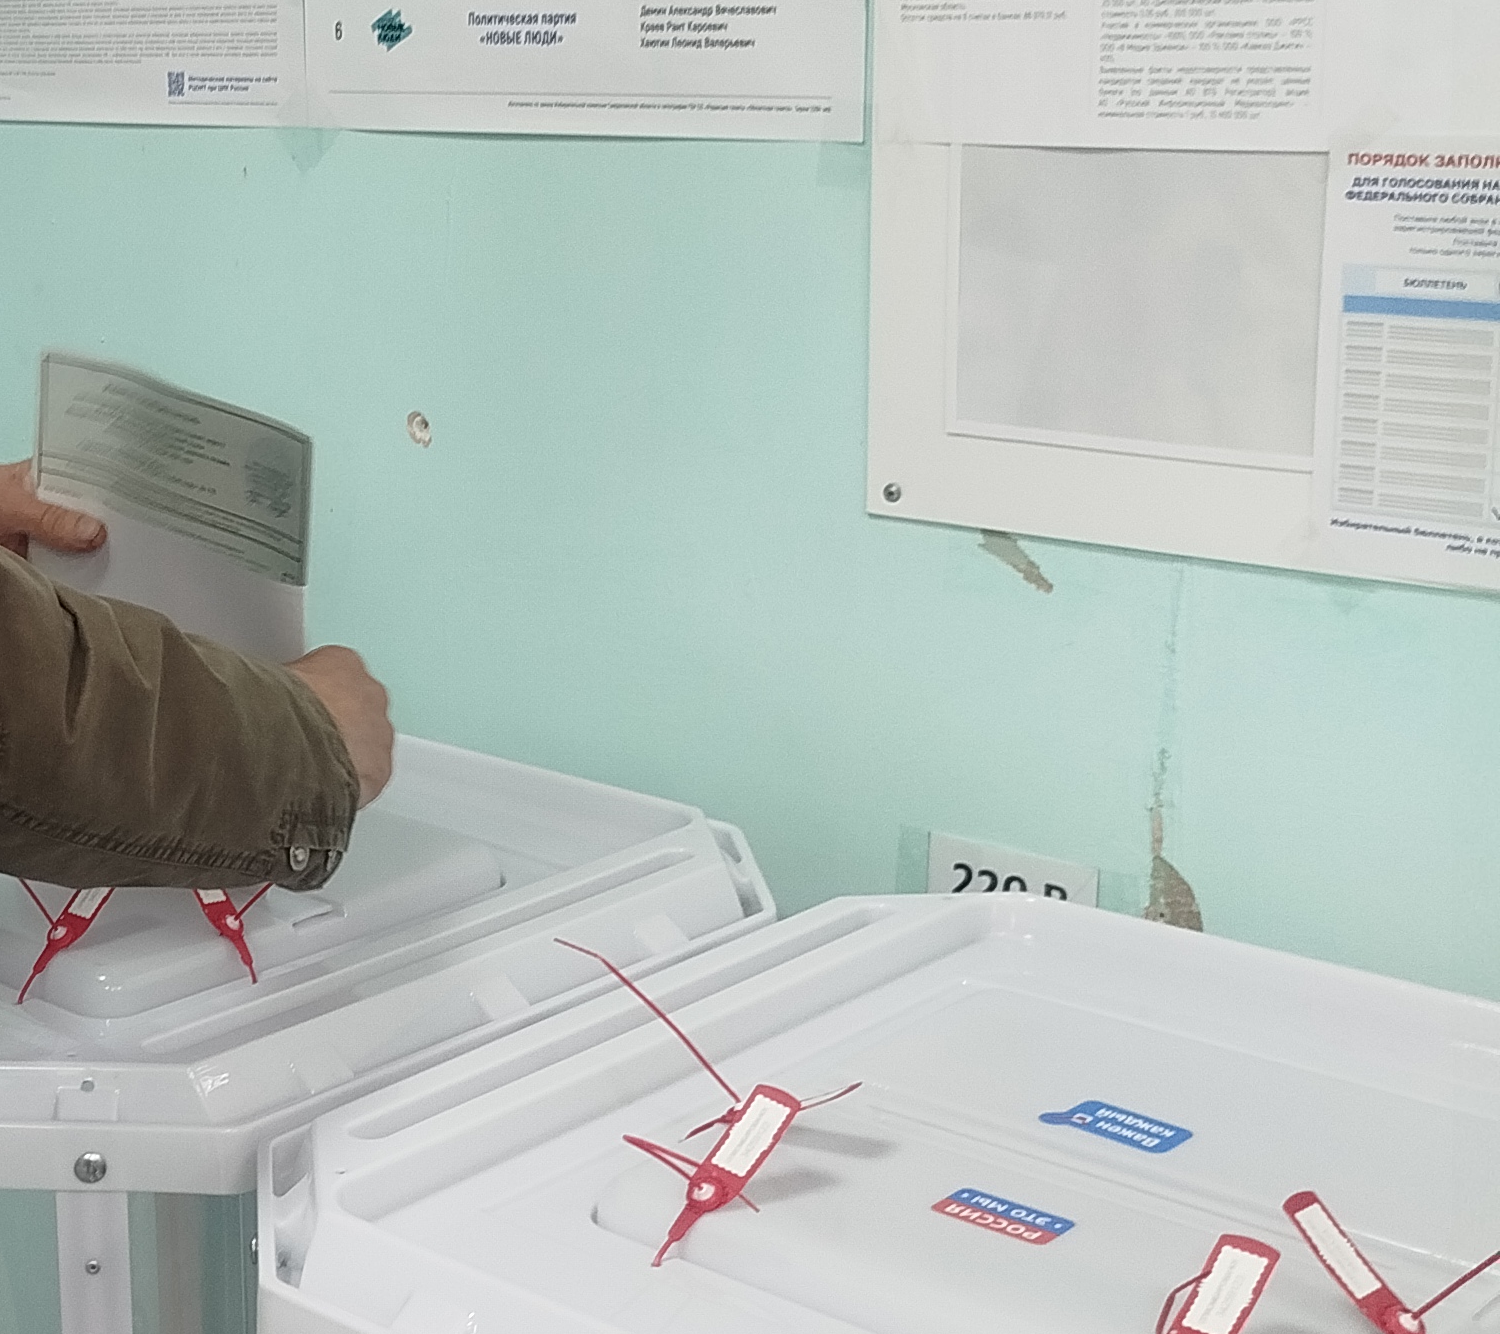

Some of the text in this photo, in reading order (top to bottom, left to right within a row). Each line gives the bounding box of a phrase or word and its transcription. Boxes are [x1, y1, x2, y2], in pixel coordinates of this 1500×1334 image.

[467, 11, 577, 27] Политическая партия
[334, 20, 343, 41] 6
[479, 29, 563, 47] «НОВЫЕ ЛЮДИ»
[1347, 152, 1430, 168] ПОРЯДОК
[1095, 1107, 1175, 1138] каждый
[973, 1194, 1051, 1227] ЭТО МЫ
[943, 1201, 1044, 1243] РОССИЯ
